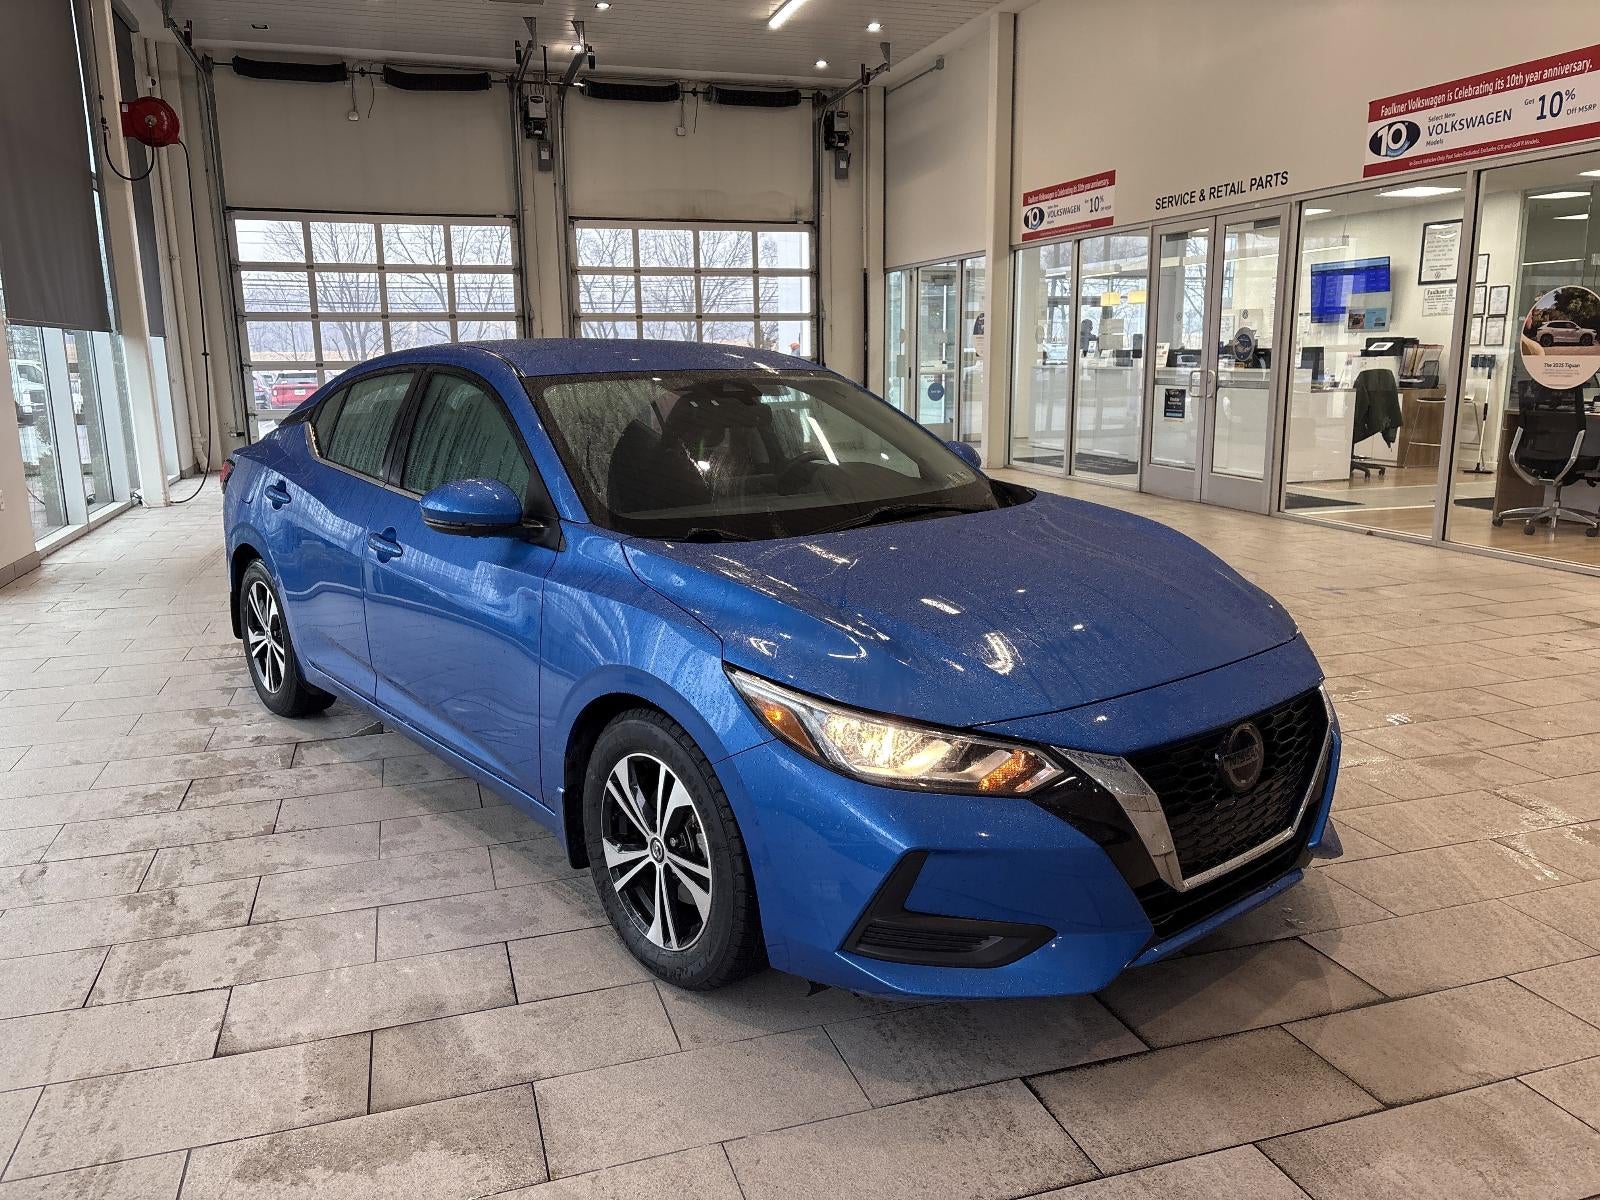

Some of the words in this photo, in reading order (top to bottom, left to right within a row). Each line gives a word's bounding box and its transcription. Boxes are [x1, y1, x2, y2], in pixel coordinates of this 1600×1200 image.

[1380, 103, 1407, 117] Faulkner
[1408, 94, 1446, 110] Volkswagen
[1447, 90, 1453, 102] is
[1454, 81, 1494, 100] Celebrating
[1495, 78, 1504, 91] its
[1506, 72, 1524, 88] 10th
[1524, 71, 1541, 87] year
[1542, 58, 1593, 80] anniversary.
[1377, 122, 1408, 156] 10
[1427, 108, 1512, 136] VOLKSWAGEN
[1155, 190, 1196, 210] SERVICE
[1199, 189, 1206, 202] &
[1208, 180, 1246, 200] RETAIL
[1249, 170, 1289, 191] PARTS
[1047, 204, 1081, 218] VOLKSWAGEN
